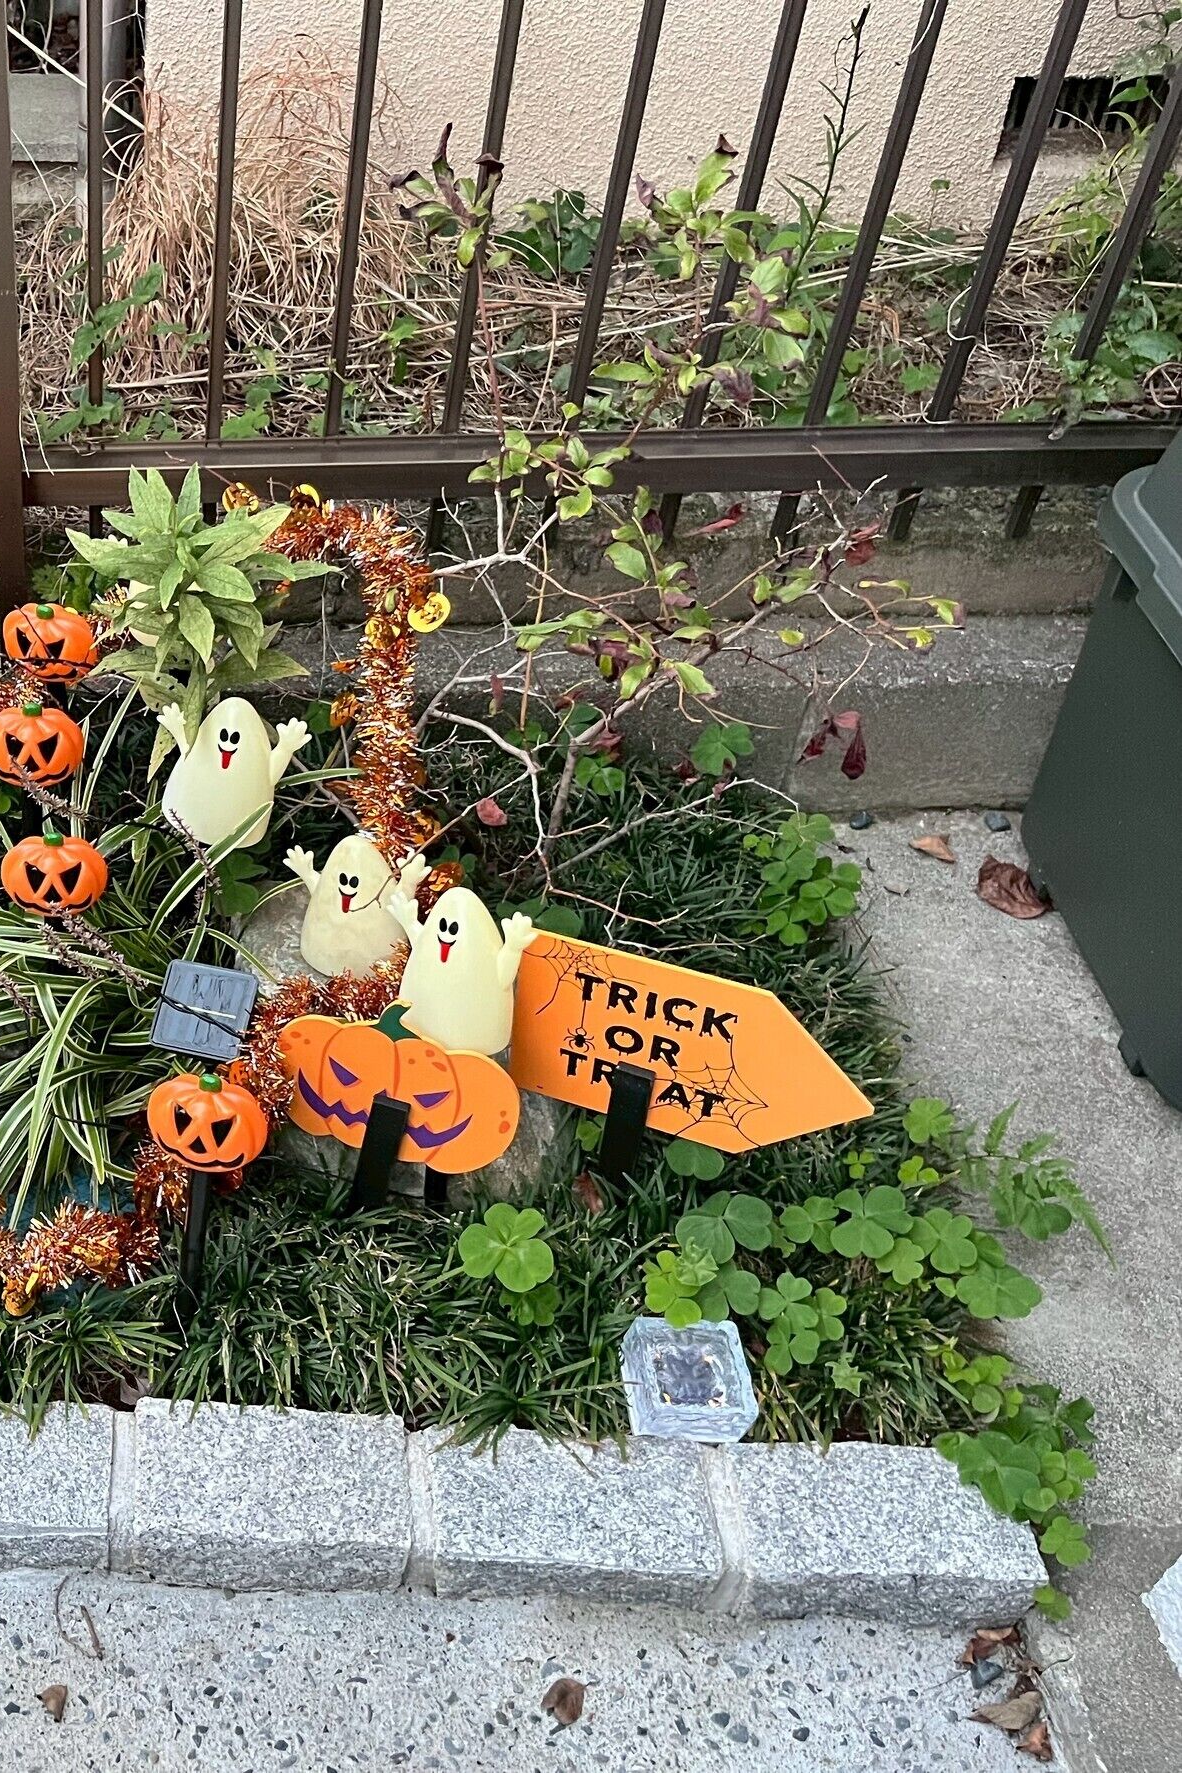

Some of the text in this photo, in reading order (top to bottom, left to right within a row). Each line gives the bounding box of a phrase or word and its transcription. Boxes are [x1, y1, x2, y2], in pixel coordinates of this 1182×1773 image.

[574, 971, 739, 1043] TRICK
[604, 1025, 681, 1069] OR
[559, 1048, 724, 1118] TRAT
